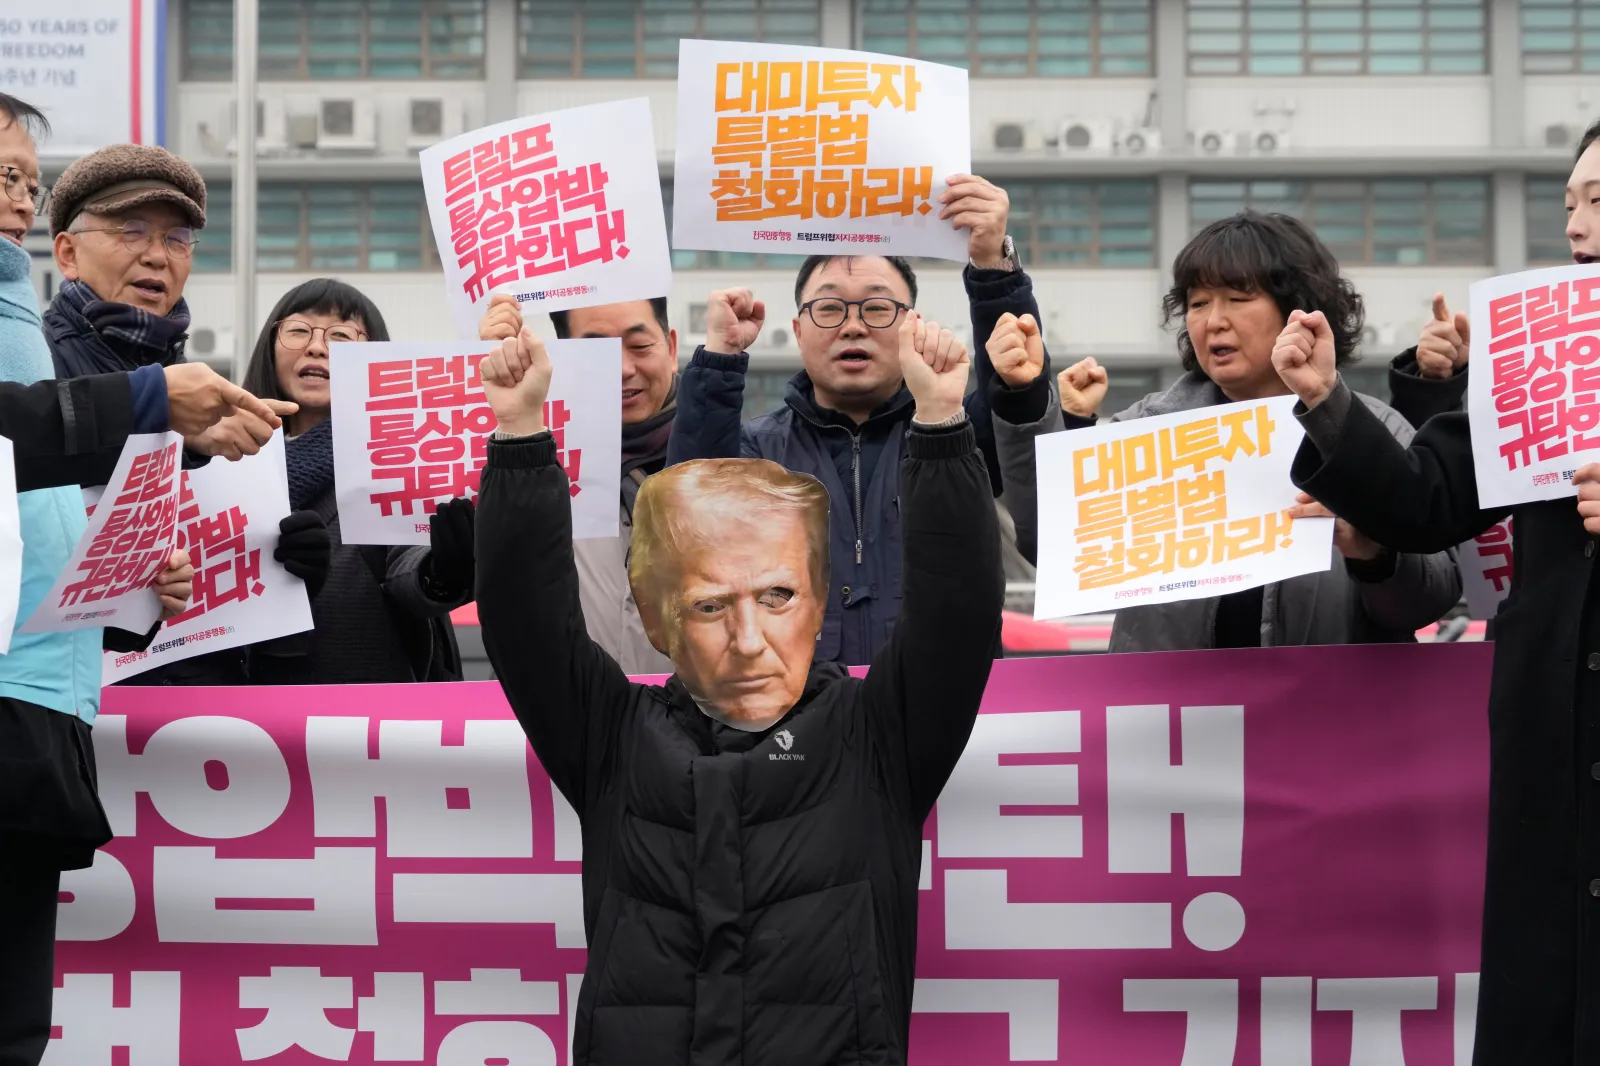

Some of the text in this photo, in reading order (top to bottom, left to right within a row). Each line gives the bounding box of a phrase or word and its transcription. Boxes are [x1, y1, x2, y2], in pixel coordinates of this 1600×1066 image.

[0, 43, 85, 59] REEDOM
[28, 19, 88, 34] YEARS
[94, 18, 119, 34] OF
[0, 68, 36, 87] 주년
[715, 61, 921, 113] 대미투자
[443, 123, 557, 207] 트럼프
[712, 114, 868, 168] 특별법
[449, 163, 609, 255] 통상압박
[709, 166, 933, 221] 철회하라!
[458, 209, 630, 304] 규탄한다!
[114, 441, 177, 506] 트럼프
[1073, 405, 1275, 497] 대미투자
[1073, 470, 1227, 544] 특별법
[1072, 509, 1294, 591] 철회하라!
